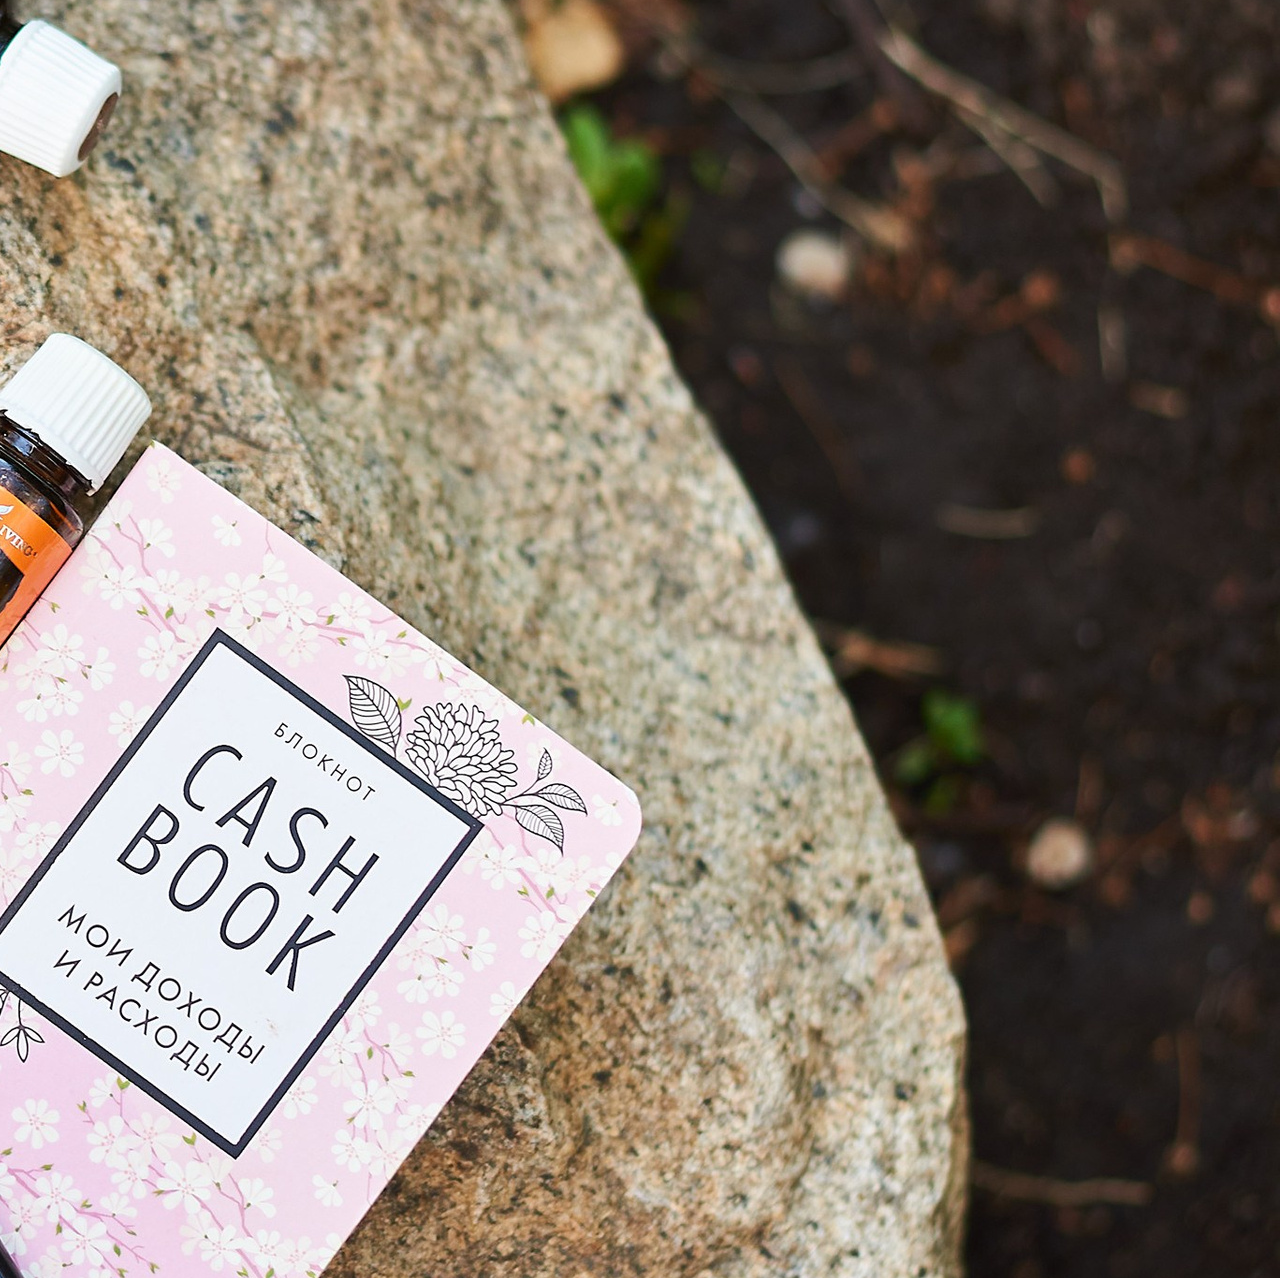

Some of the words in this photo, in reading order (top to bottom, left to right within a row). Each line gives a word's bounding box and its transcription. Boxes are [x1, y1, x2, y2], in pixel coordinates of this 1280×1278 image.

[183, 745, 379, 913] CASH
[274, 723, 376, 801] БЛОКНОТ
[117, 804, 336, 991] BOOK
[54, 950, 81, 977] И
[83, 972, 222, 1082] РАСХОДЫ
[58, 905, 134, 967] МОИ
[131, 962, 266, 1065] ДОХОДЫ
